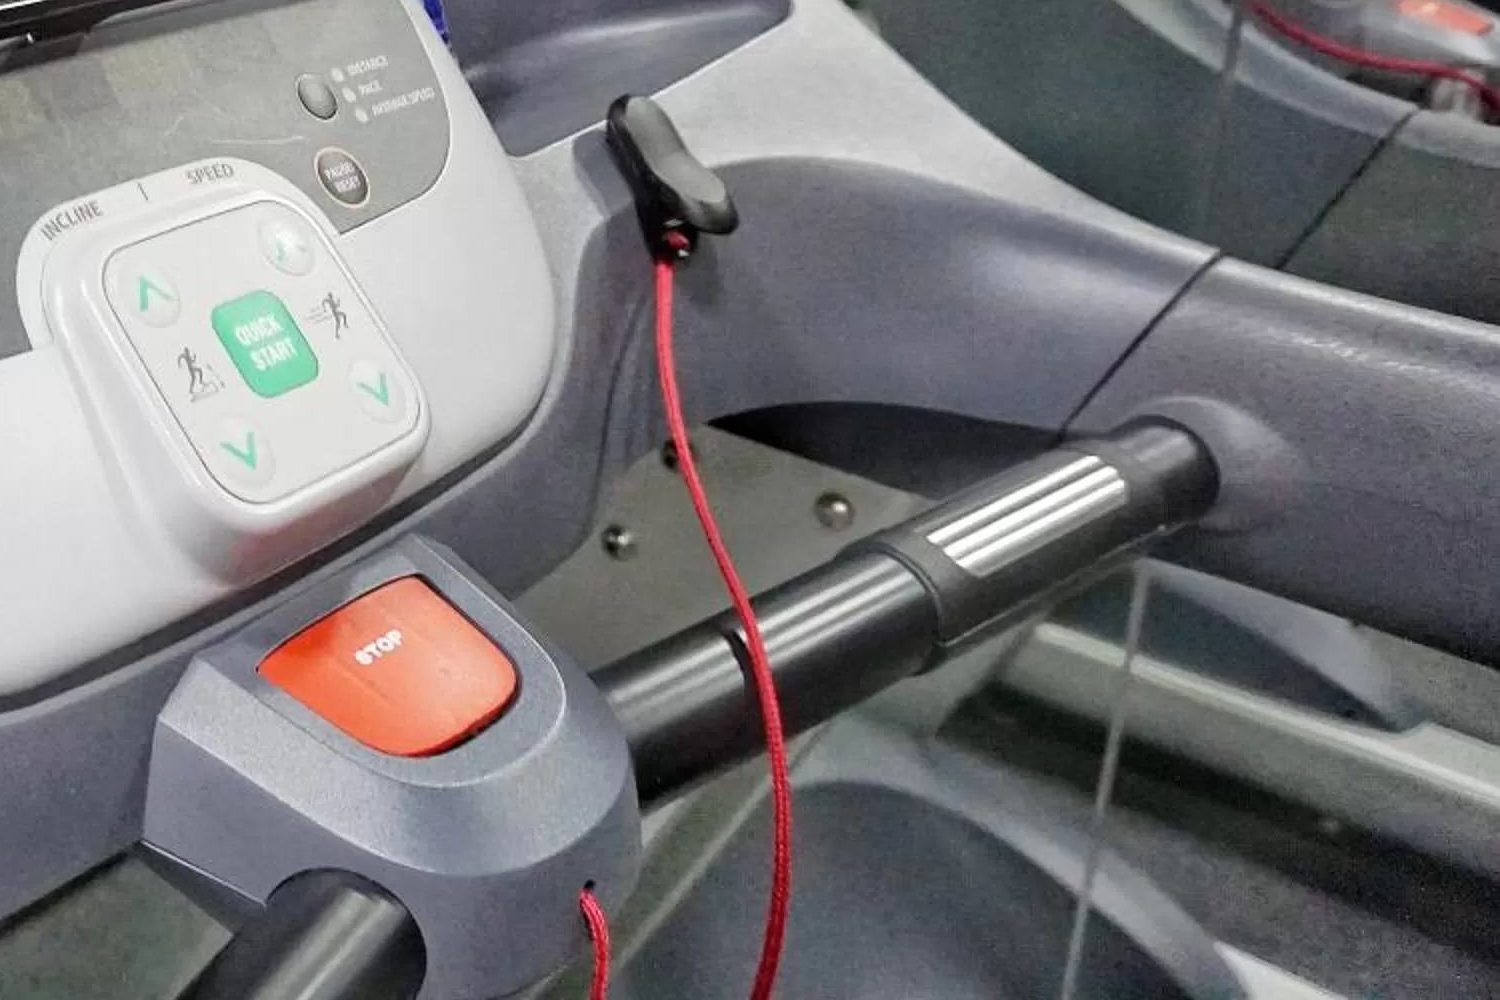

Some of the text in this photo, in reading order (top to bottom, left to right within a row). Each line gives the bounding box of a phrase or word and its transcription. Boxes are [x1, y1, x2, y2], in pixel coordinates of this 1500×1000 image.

[186, 163, 235, 186] SPEED
[41, 201, 104, 241] INCLINE
[235, 312, 285, 346] QUICK
[251, 341, 298, 372] START
[355, 629, 402, 665] STOP
